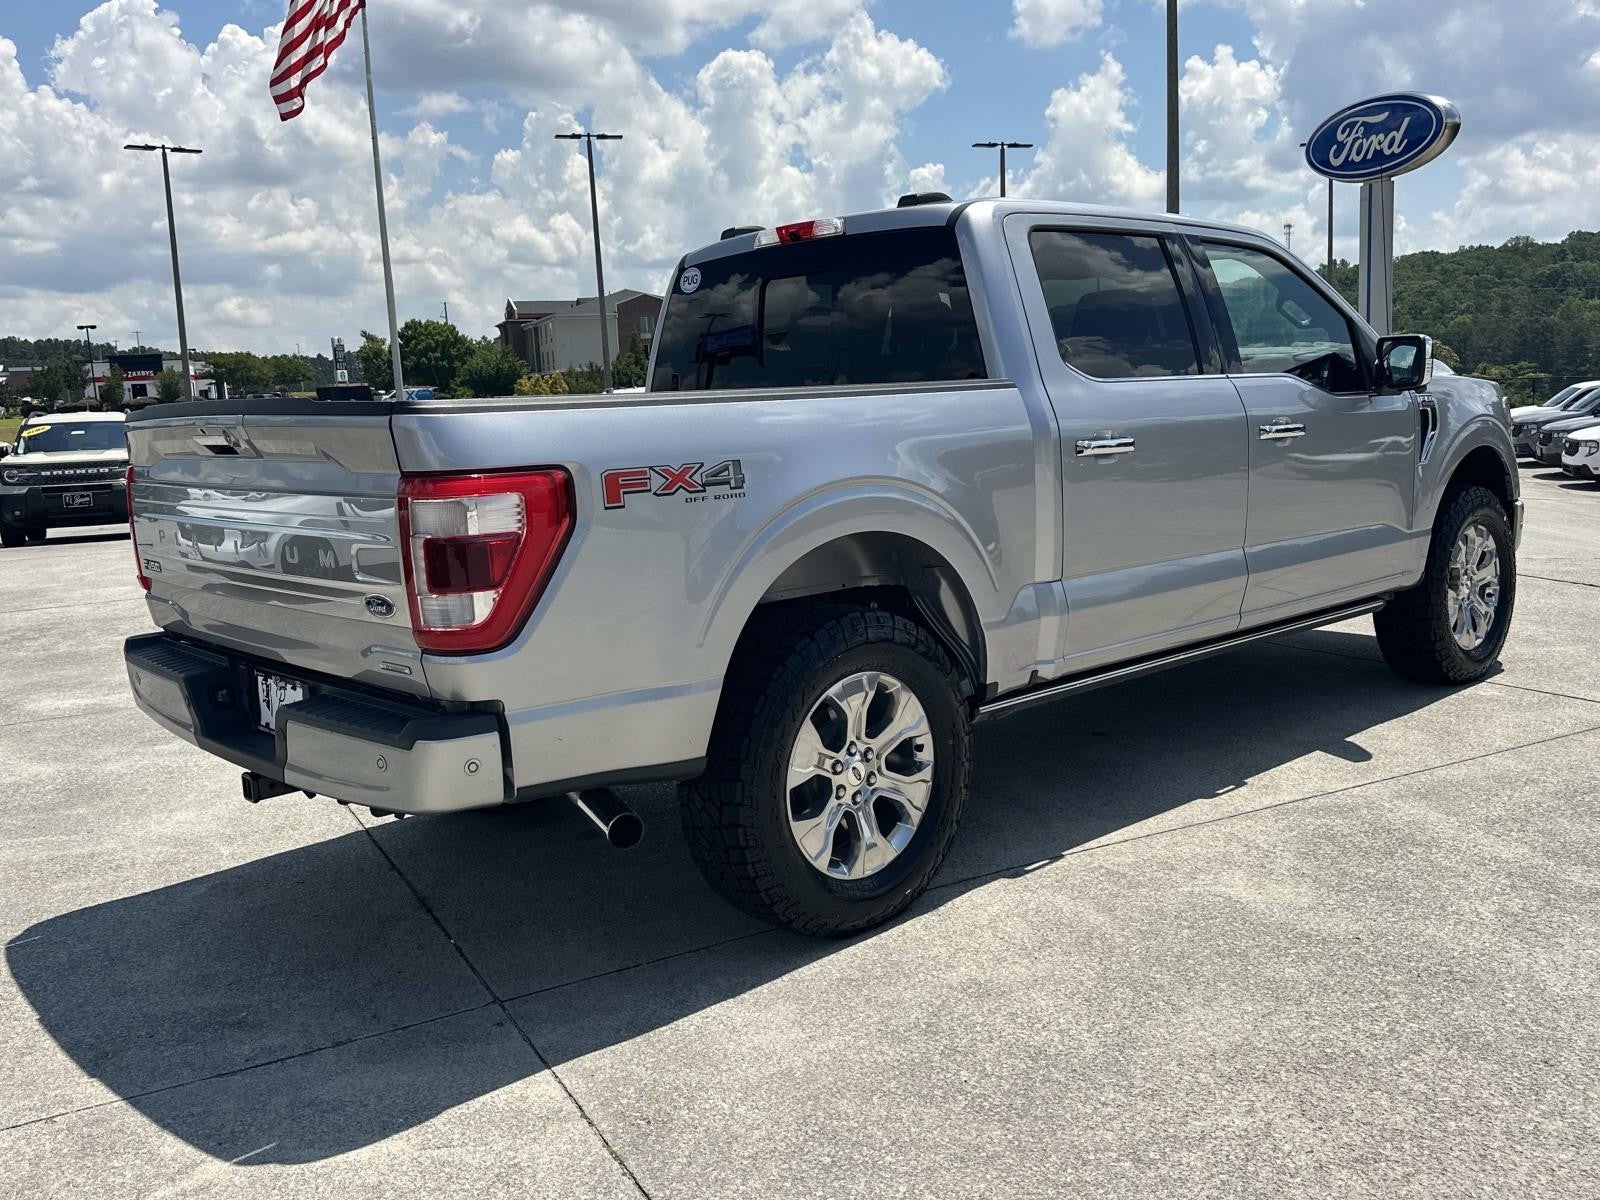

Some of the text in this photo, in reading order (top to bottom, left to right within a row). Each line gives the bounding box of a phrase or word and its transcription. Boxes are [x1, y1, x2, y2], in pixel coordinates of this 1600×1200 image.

[1329, 111, 1411, 167] Ford
[682, 274, 698, 286] PUG
[127, 370, 154, 378] ZAXBYS
[41, 468, 109, 476] BRONCO
[600, 459, 746, 510] FX4
[714, 492, 746, 500] ROAD
[158, 528, 336, 569] PLATINUM
[369, 598, 387, 613] Ford
